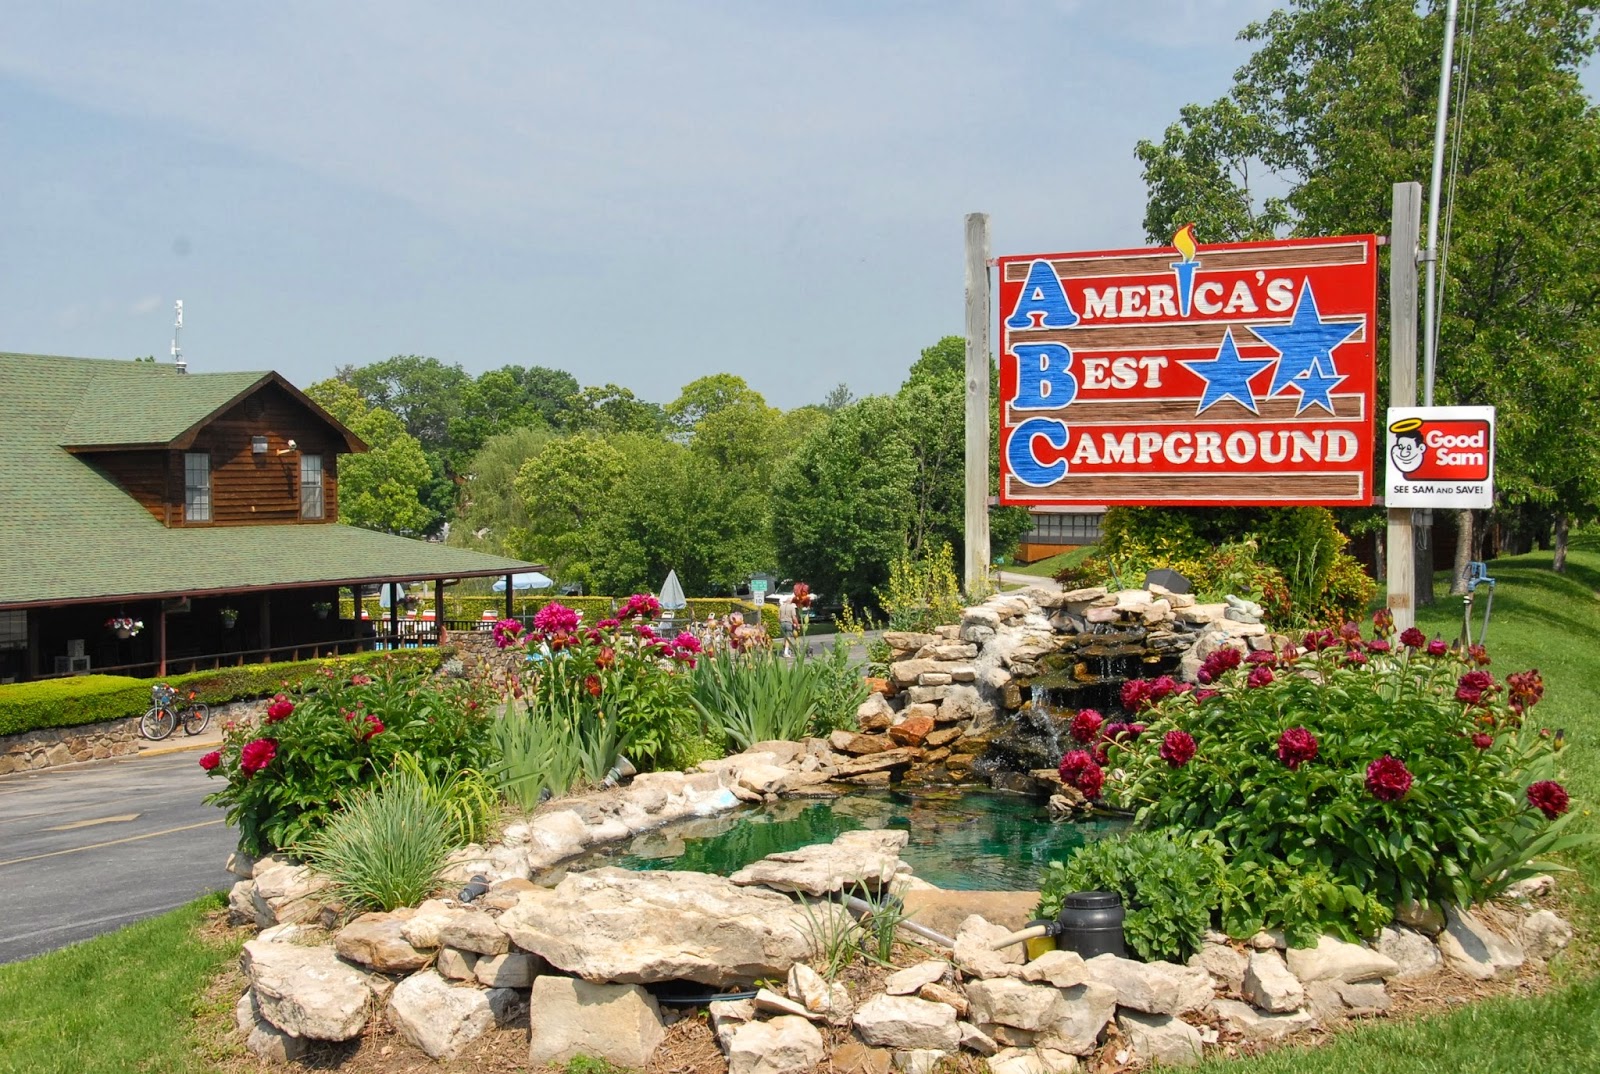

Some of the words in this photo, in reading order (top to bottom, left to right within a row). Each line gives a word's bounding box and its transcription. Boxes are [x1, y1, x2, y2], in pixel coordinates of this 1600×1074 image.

[1005, 258, 1294, 329] AMERICA'S
[1010, 341, 1168, 410] BEST
[1006, 417, 1358, 487] CAMPGROUND
[1426, 430, 1484, 448] Good
[1436, 448, 1483, 466] Sam
[1394, 485, 1409, 494] SEE
[1412, 485, 1434, 494] SAM
[1456, 486, 1483, 494] SAVE!
